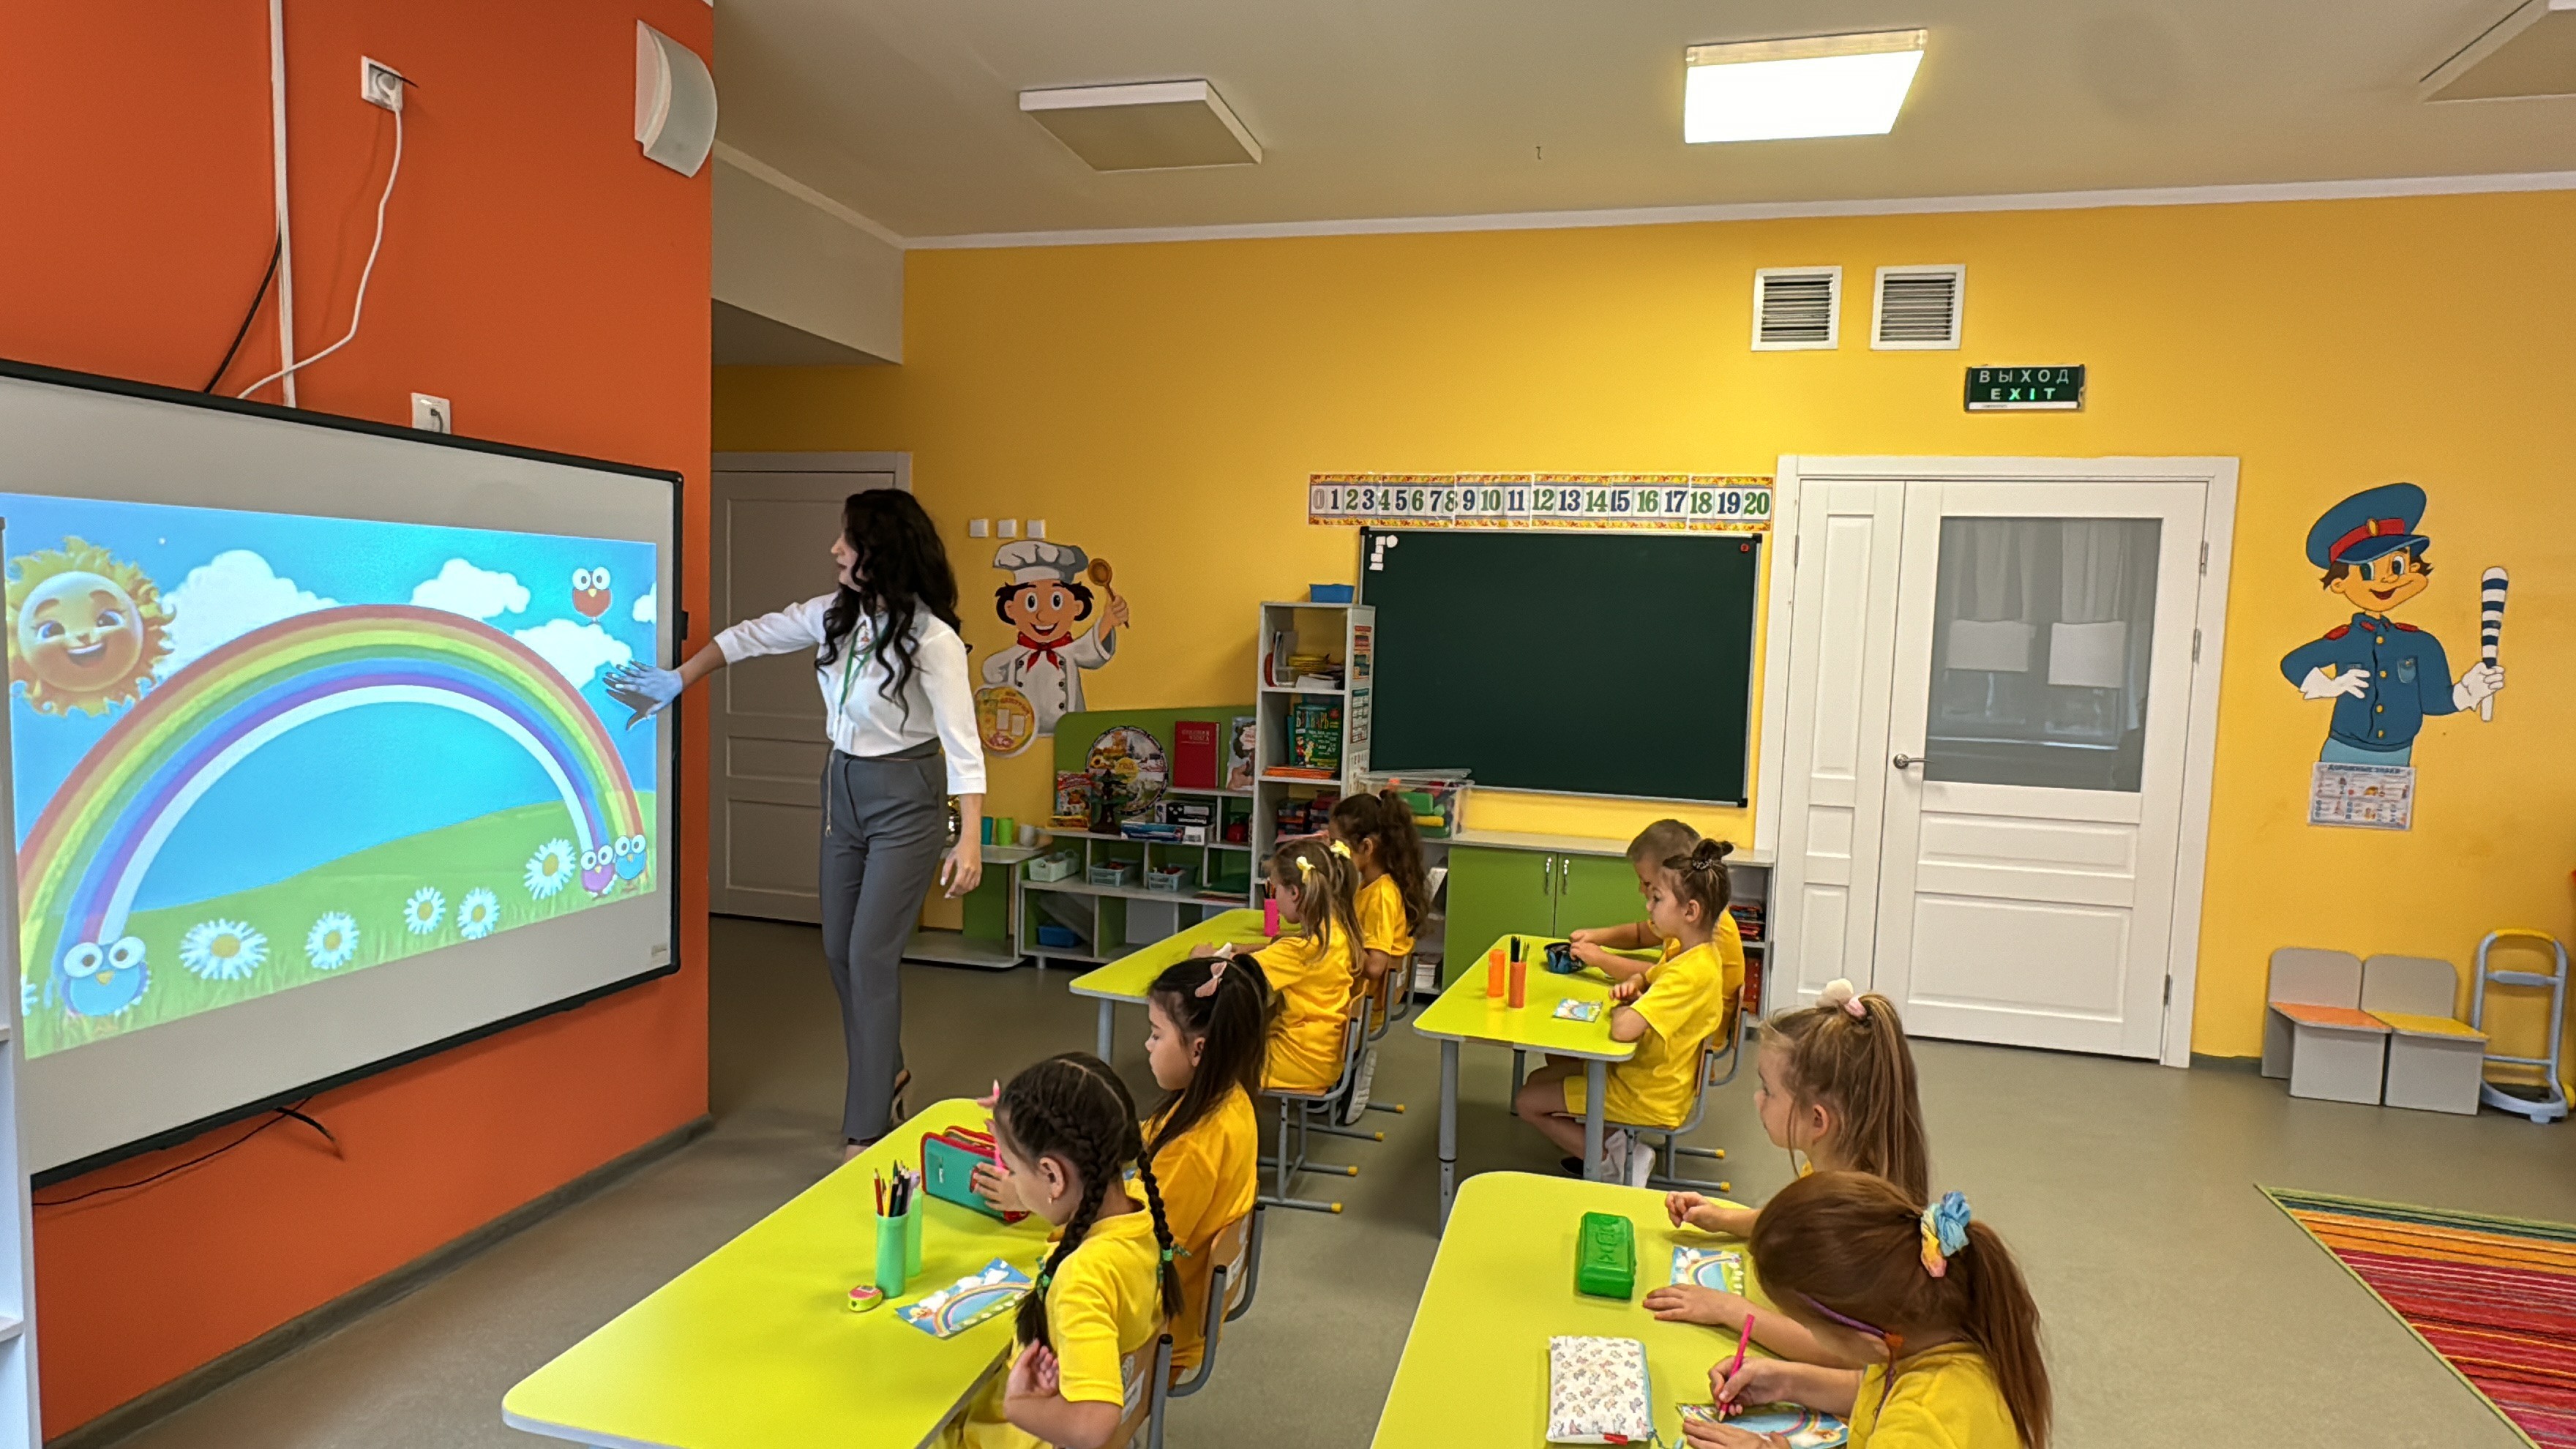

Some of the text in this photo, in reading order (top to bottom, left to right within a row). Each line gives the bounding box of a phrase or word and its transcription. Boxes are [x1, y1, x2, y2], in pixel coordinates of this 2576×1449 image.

[1979, 369, 2070, 384] ВЫХОД
[1991, 388, 2056, 400] EXIT
[1314, 488, 1770, 514] 0 1 2 3 4 5 6 7 8 9 10 11 12 13 14 15 16 17 18 19 20
[1296, 711, 1330, 729] БУКВАРЬ
